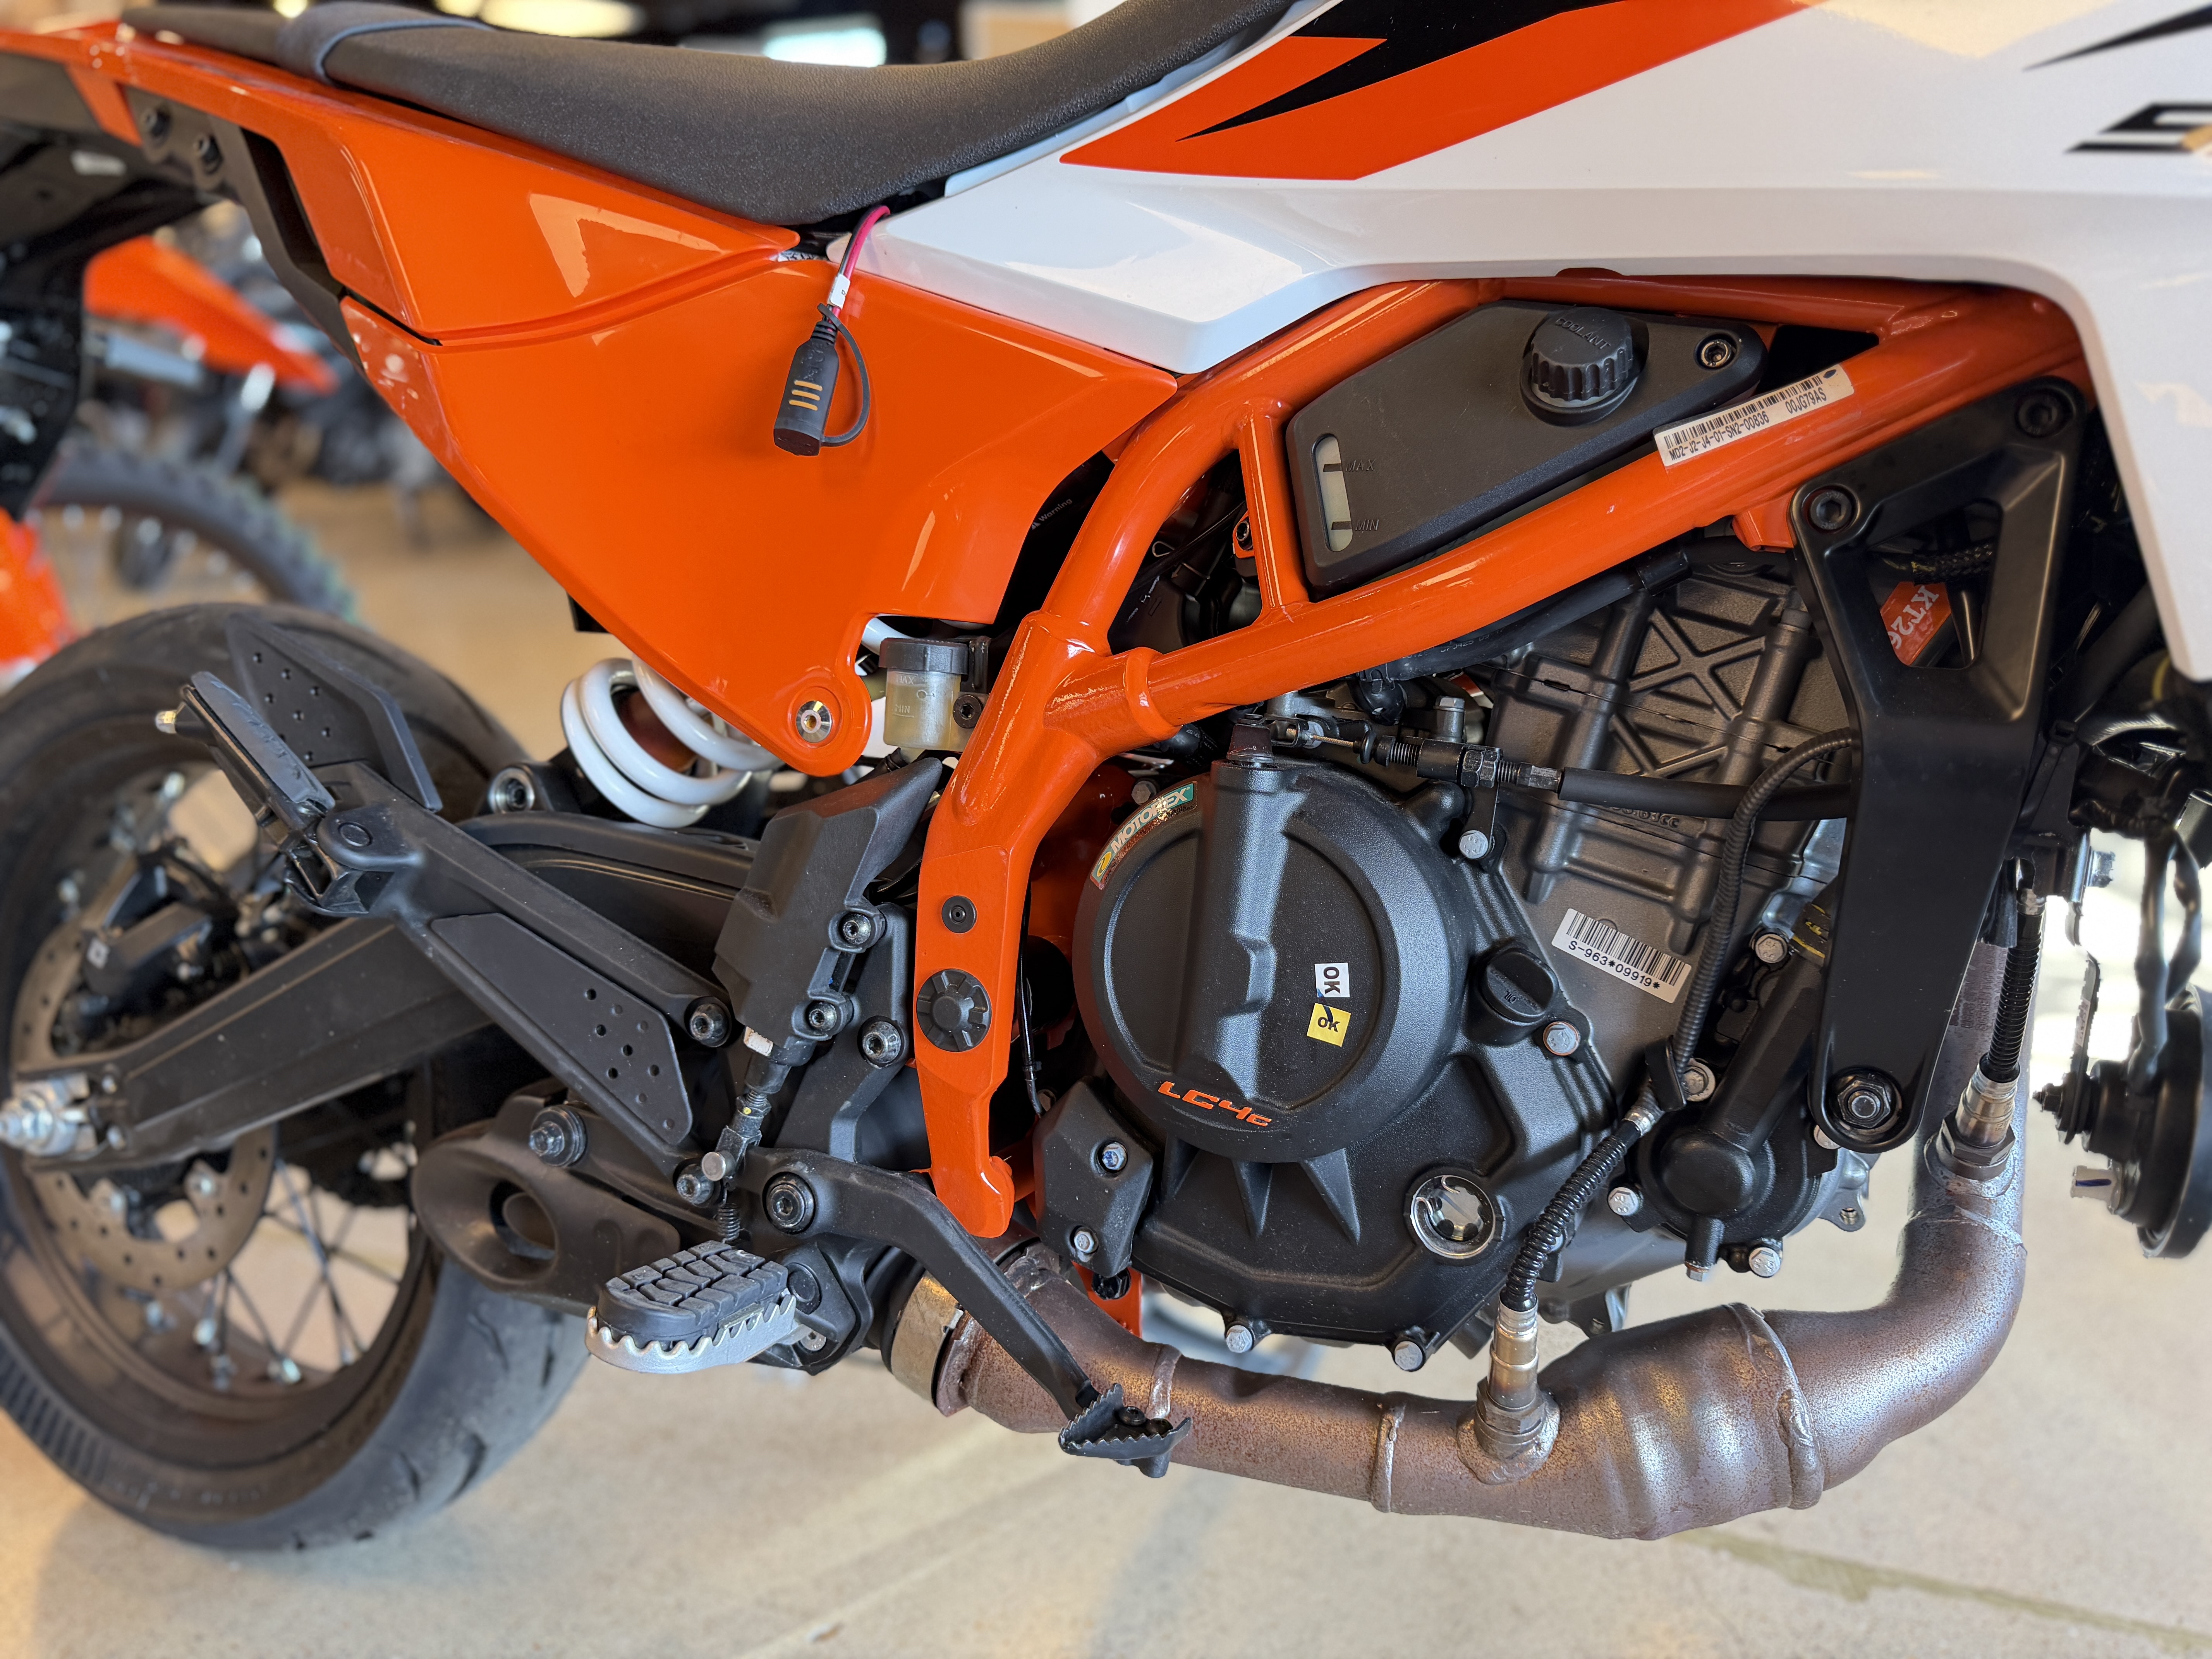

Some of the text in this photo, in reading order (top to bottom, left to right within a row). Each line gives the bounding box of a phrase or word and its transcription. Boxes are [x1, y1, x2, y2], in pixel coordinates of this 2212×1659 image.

[1555, 318, 1611, 349] COOLANT
[1785, 387, 1827, 414] 00JG79AS
[1346, 459, 1375, 472] MAX
[1038, 498, 1073, 522] Warning
[1355, 519, 1379, 531] MIN
[895, 704, 910, 714] MIN
[1323, 966, 1341, 994] OK
[1317, 1017, 1341, 1033] OK
